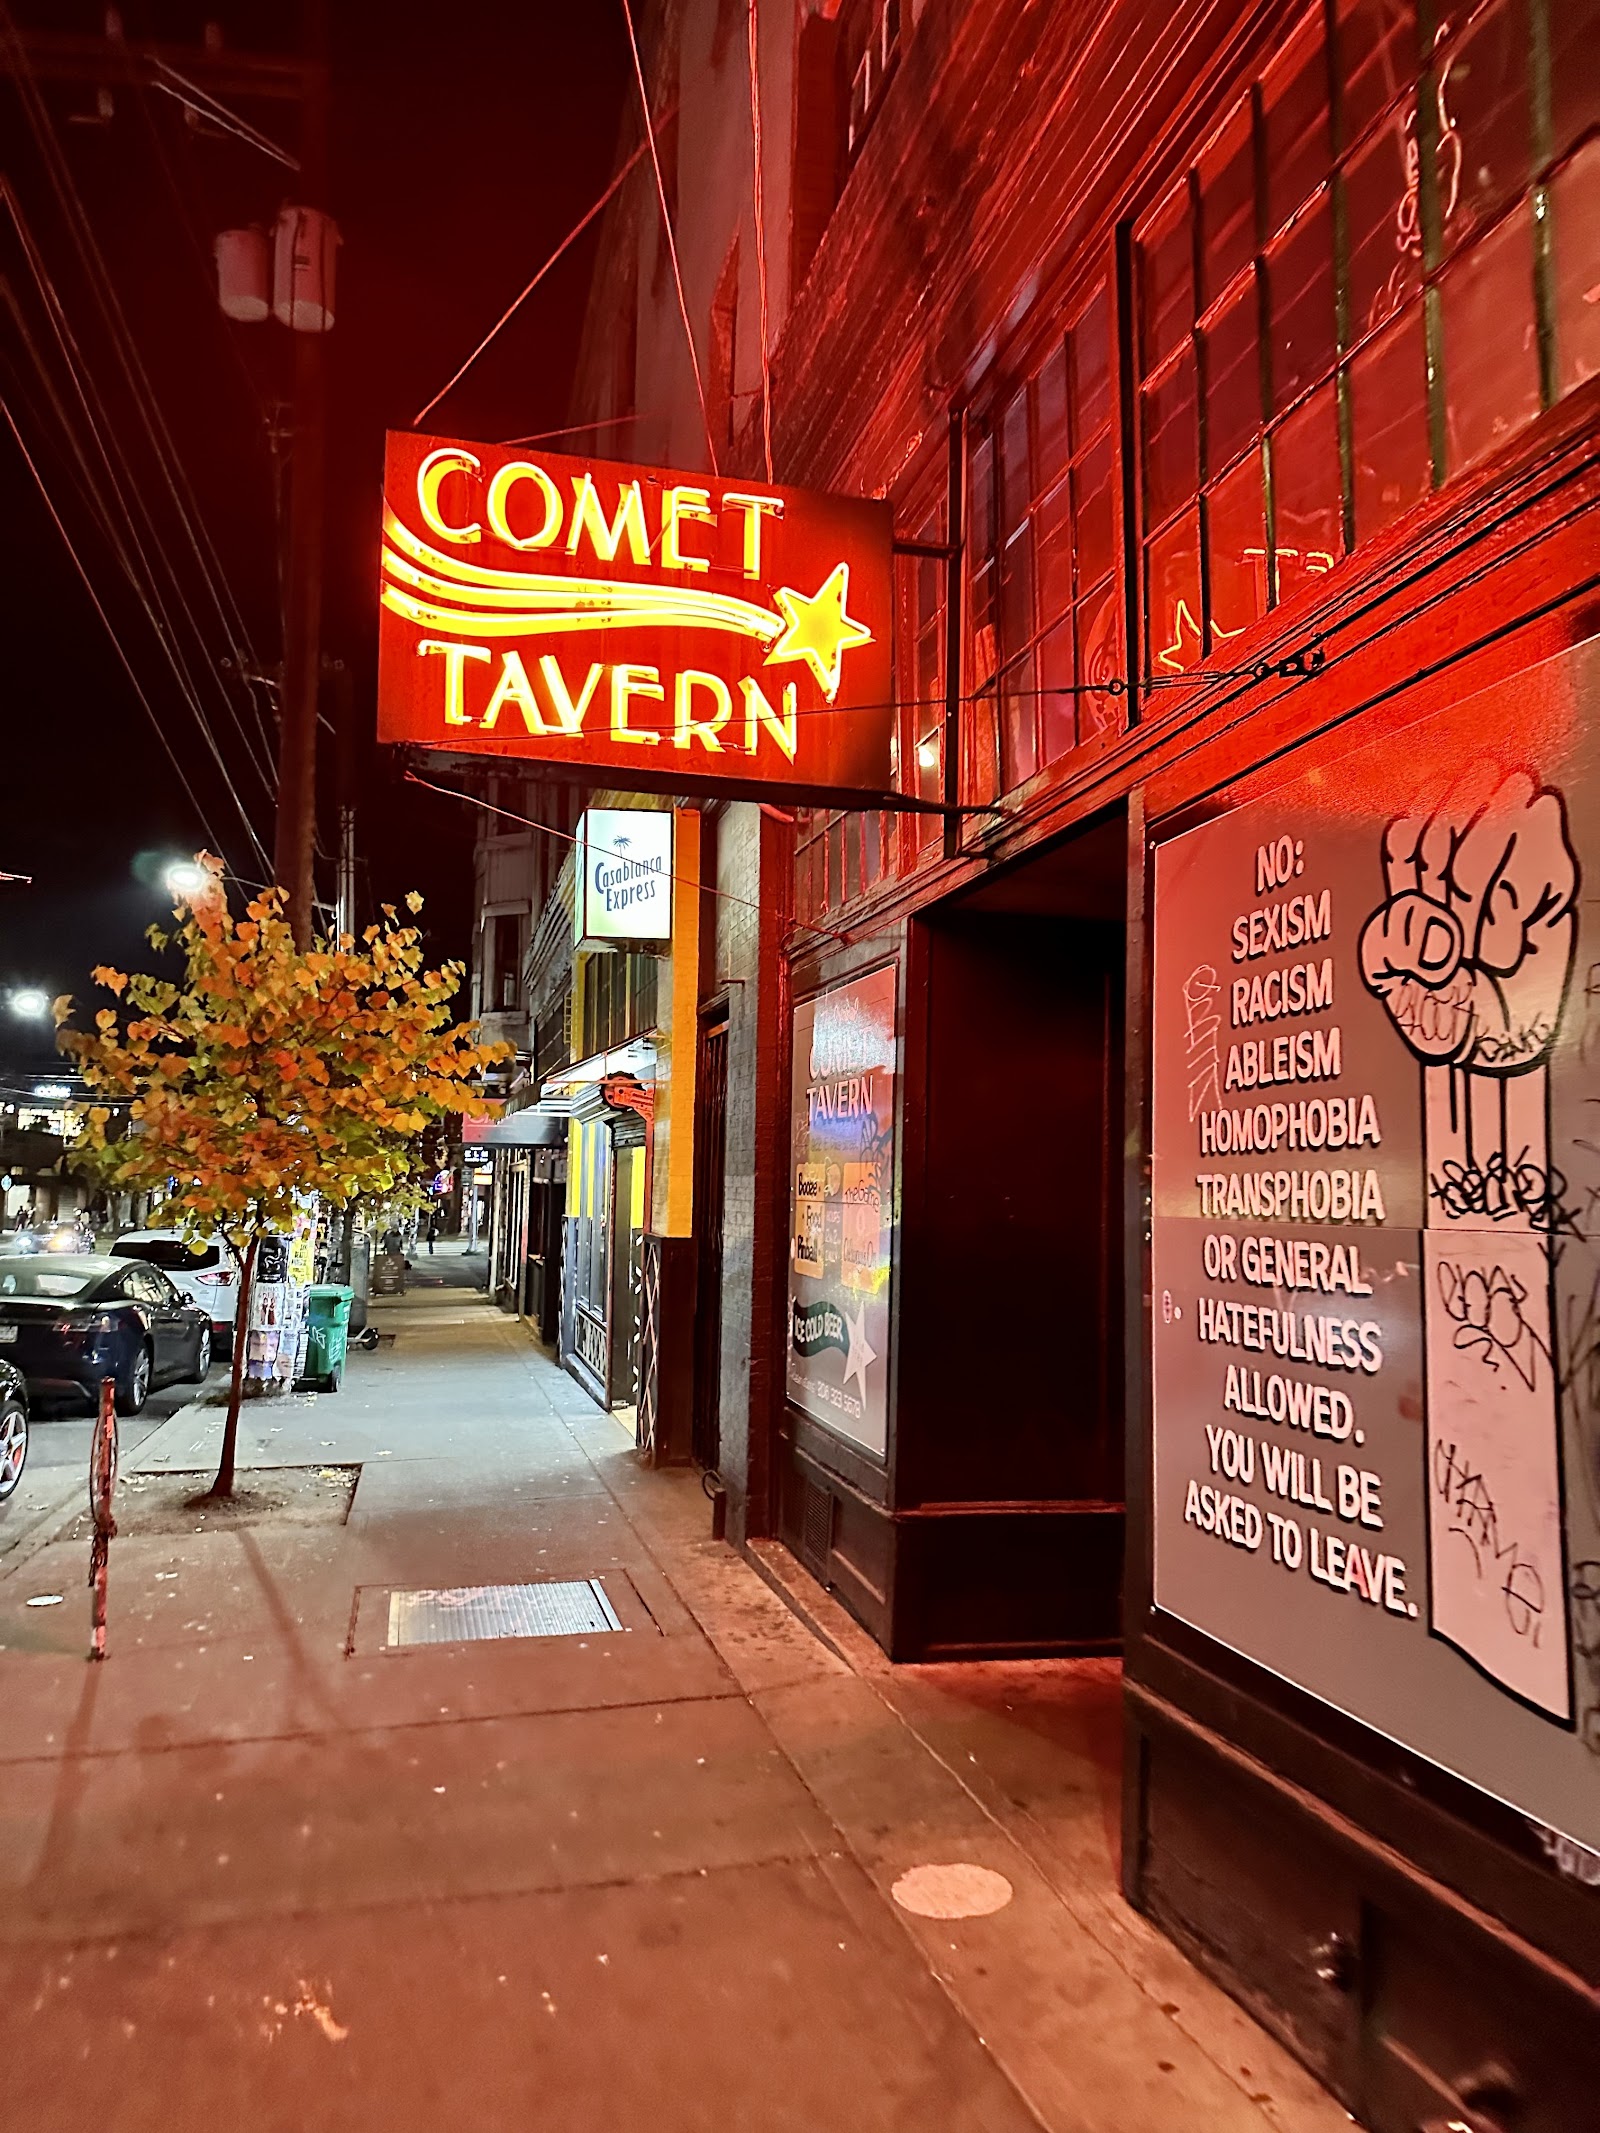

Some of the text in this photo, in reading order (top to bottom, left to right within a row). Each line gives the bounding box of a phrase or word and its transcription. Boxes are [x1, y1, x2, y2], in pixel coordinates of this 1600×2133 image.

[417, 447, 784, 580] COMET
[416, 638, 798, 765] TAVERN
[595, 856, 661, 895] Casablanca
[606, 880, 656, 911] Express
[1256, 834, 1305, 894] NO:
[1231, 889, 1331, 960] SEXISM
[1232, 958, 1333, 1026] RACISM
[1225, 1027, 1341, 1090] ABLEISM
[806, 1075, 873, 1123] TAVERN
[1201, 1094, 1381, 1154] HOMOPHOBIA
[1197, 1169, 1385, 1220] TRANSPHOBIA
[1204, 1234, 1373, 1295] OR GENERAL
[795, 1311, 844, 1343] ICE COLD BEER
[1199, 1297, 1383, 1372] HATEFULNESS
[1224, 1364, 1364, 1443] ALLOWED.
[1205, 1424, 1383, 1528] YOU WILL BE
[1184, 1480, 1420, 1618] ASKED TO LEAVE.
